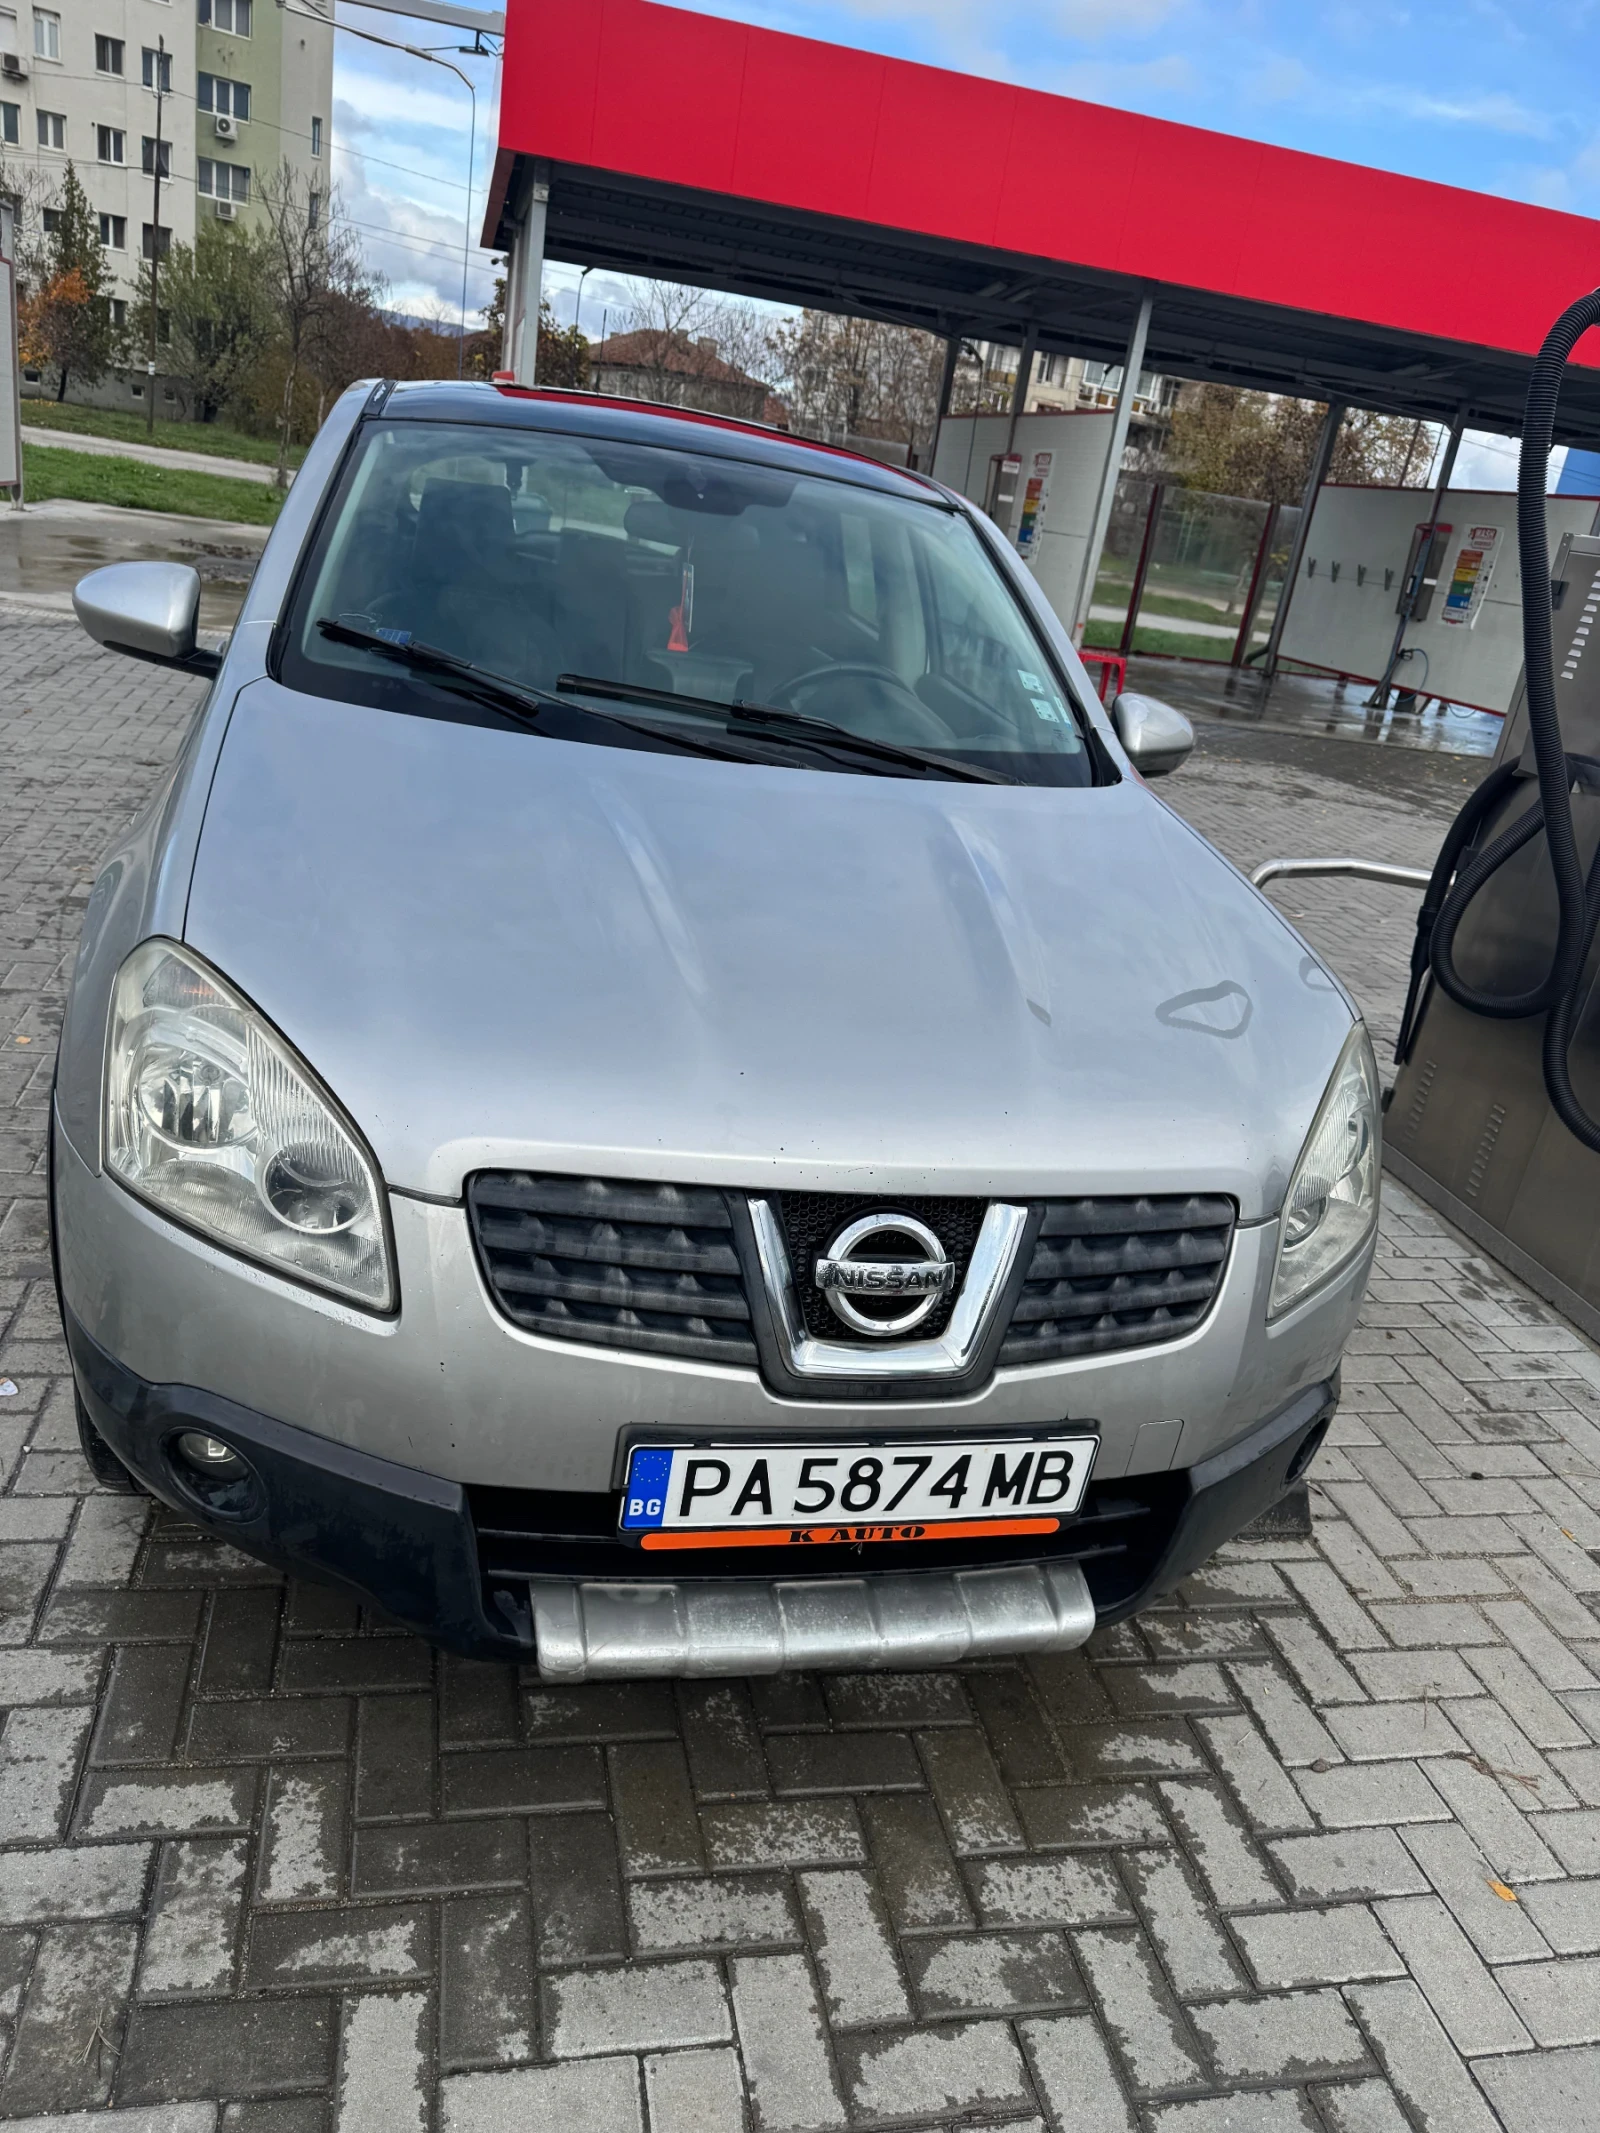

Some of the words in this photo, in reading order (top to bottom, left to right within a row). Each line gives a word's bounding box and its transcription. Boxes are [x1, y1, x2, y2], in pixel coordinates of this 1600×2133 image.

[833, 1268, 943, 1290] NISSAN
[678, 1458, 773, 1517] PA
[793, 1453, 973, 1514] 5874
[981, 1449, 1075, 1507] MB
[628, 1498, 662, 1517] BG
[788, 1529, 815, 1544] K
[828, 1525, 926, 1543] AUTO
